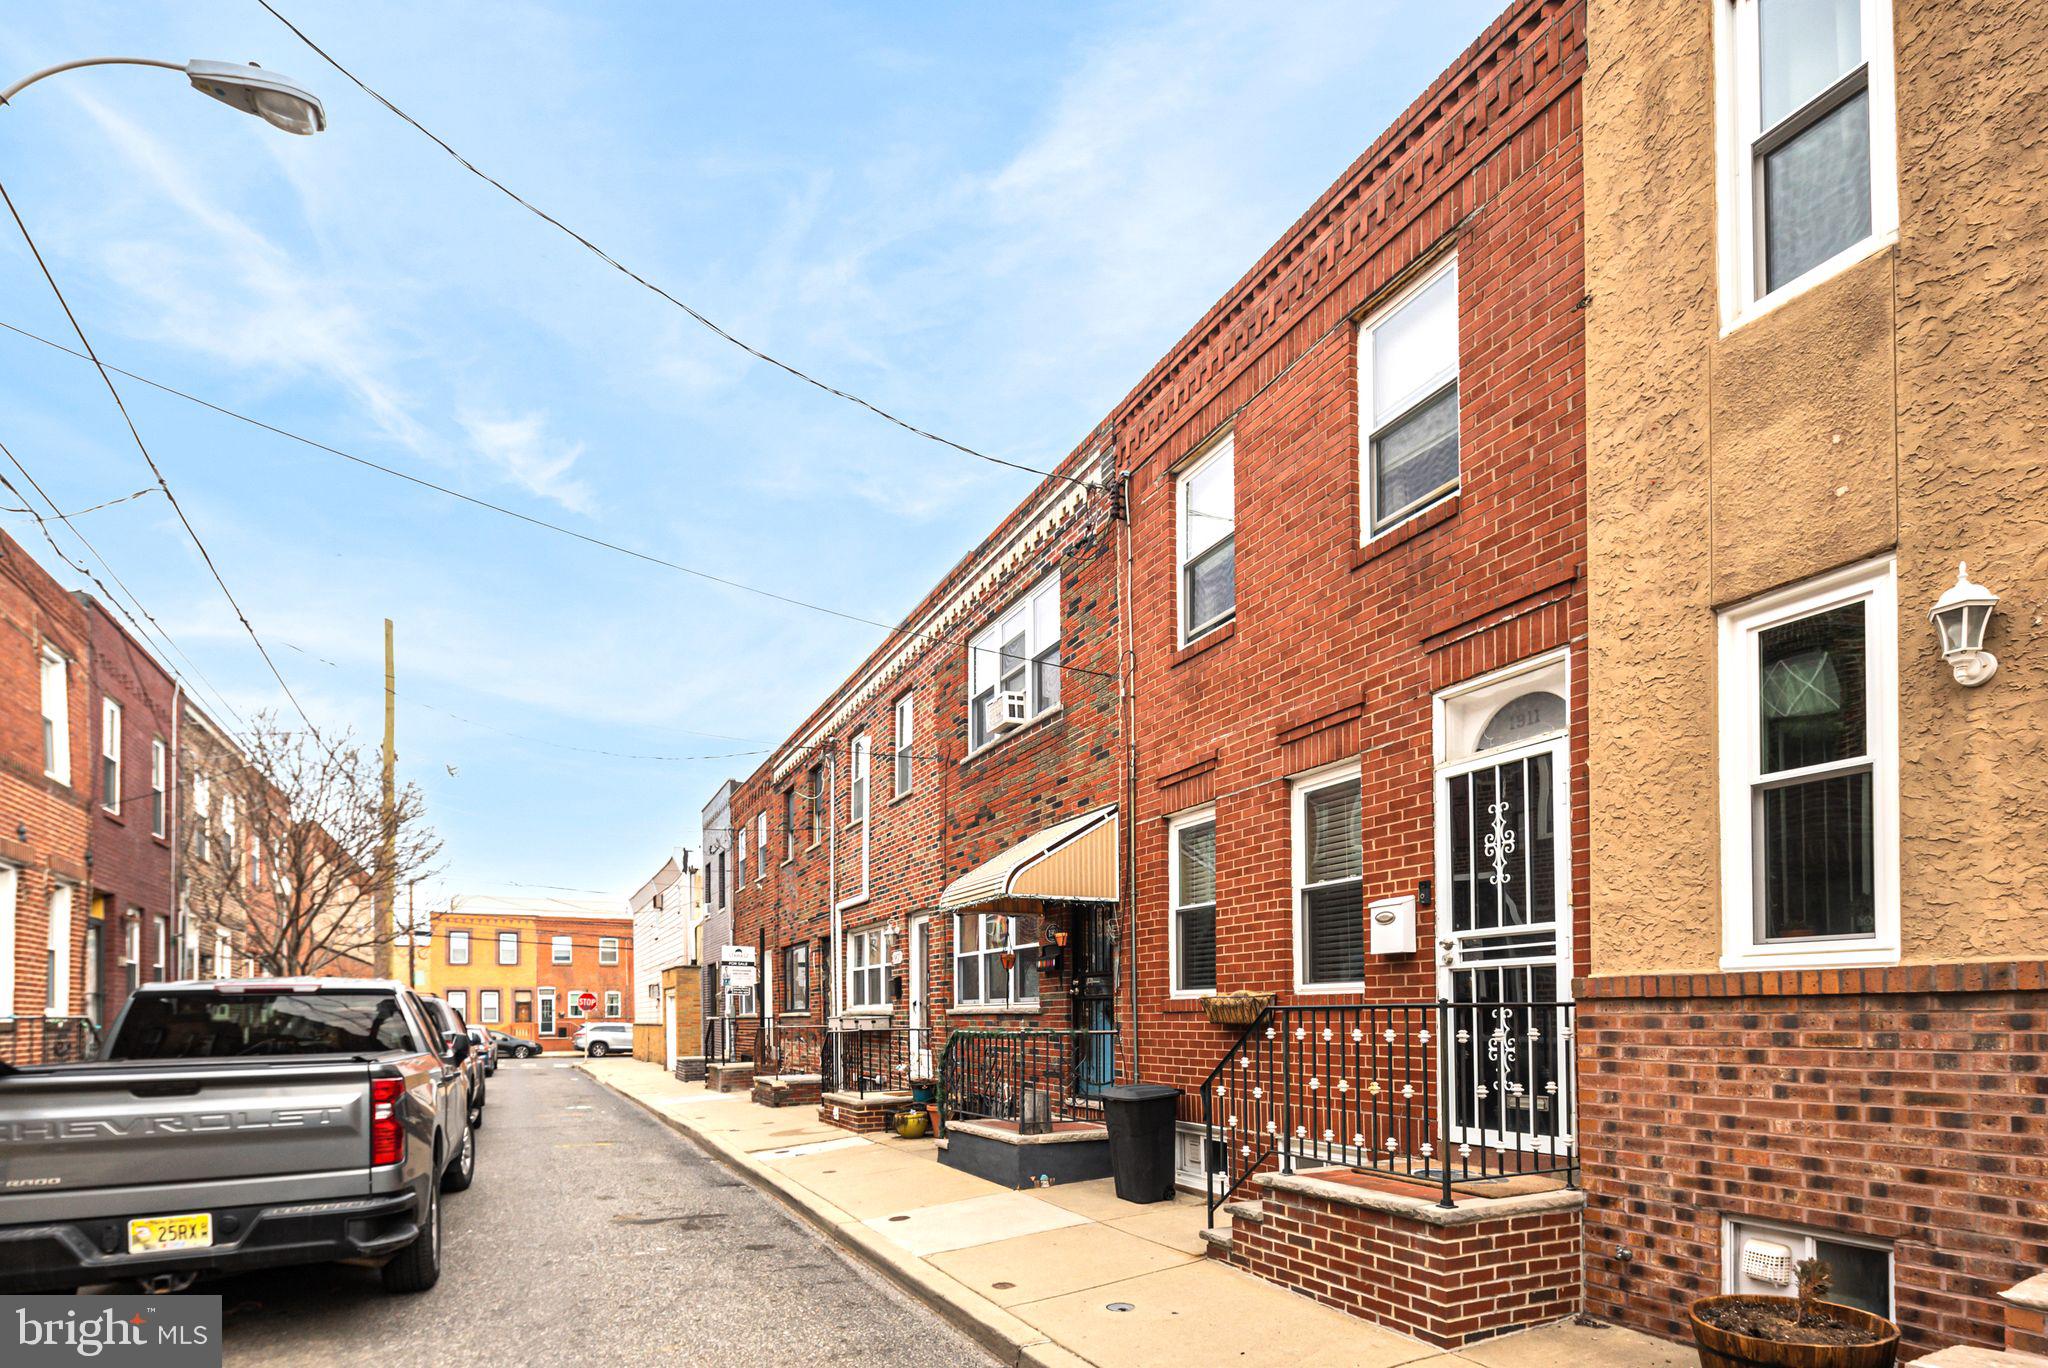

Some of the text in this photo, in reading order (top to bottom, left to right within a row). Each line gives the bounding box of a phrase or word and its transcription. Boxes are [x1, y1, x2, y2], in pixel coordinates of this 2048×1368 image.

[1510, 709, 1540, 730] 1911
[579, 998, 596, 1006] STOP
[0, 1107, 343, 1141] HEVROLET
